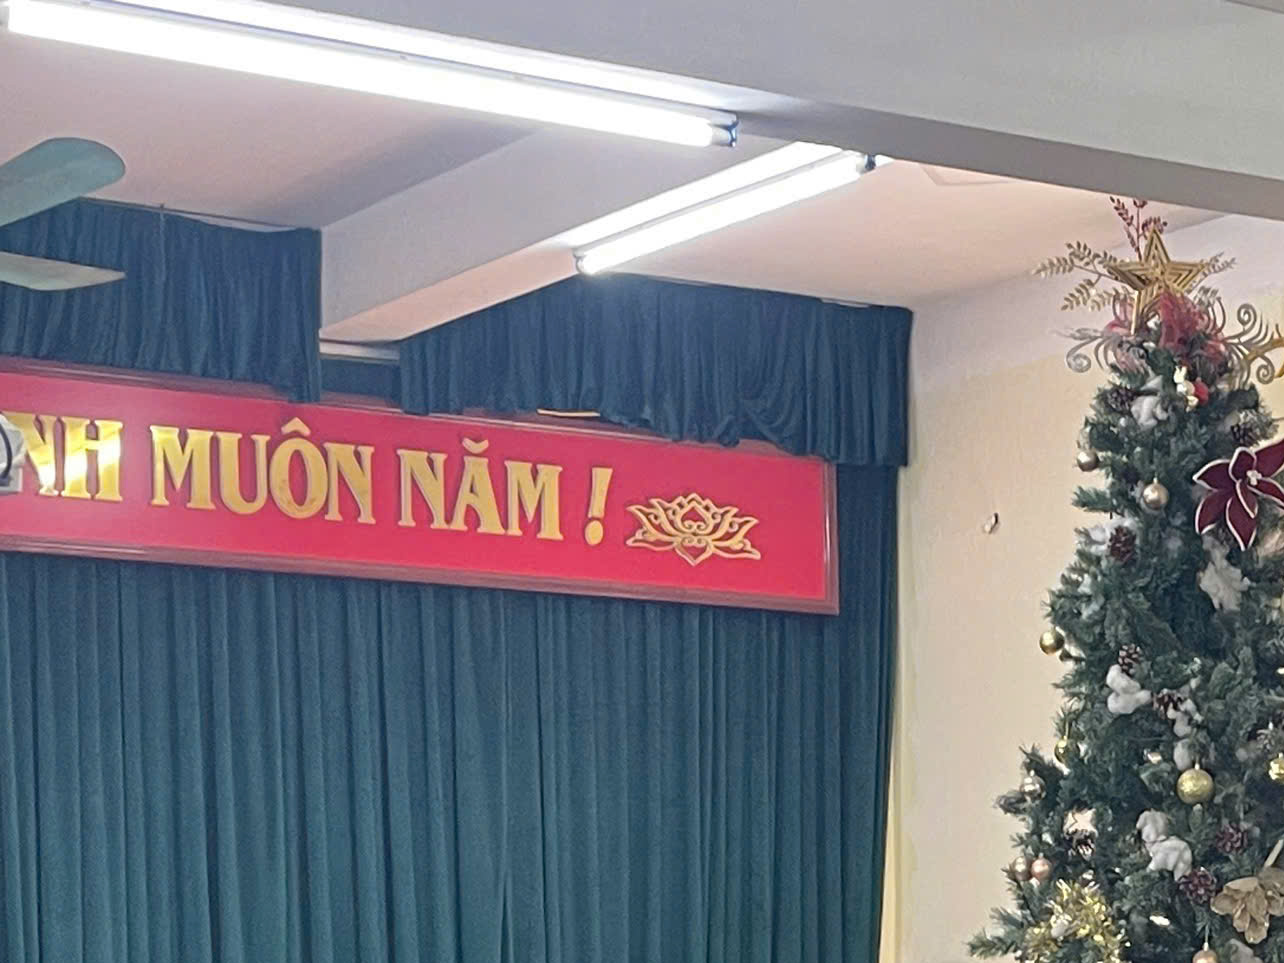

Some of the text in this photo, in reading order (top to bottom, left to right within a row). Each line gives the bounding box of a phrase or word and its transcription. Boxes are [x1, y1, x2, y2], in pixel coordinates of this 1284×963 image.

[149, 416, 376, 525] MUÔN
[396, 437, 564, 541] NĂM
[584, 467, 613, 546] !
